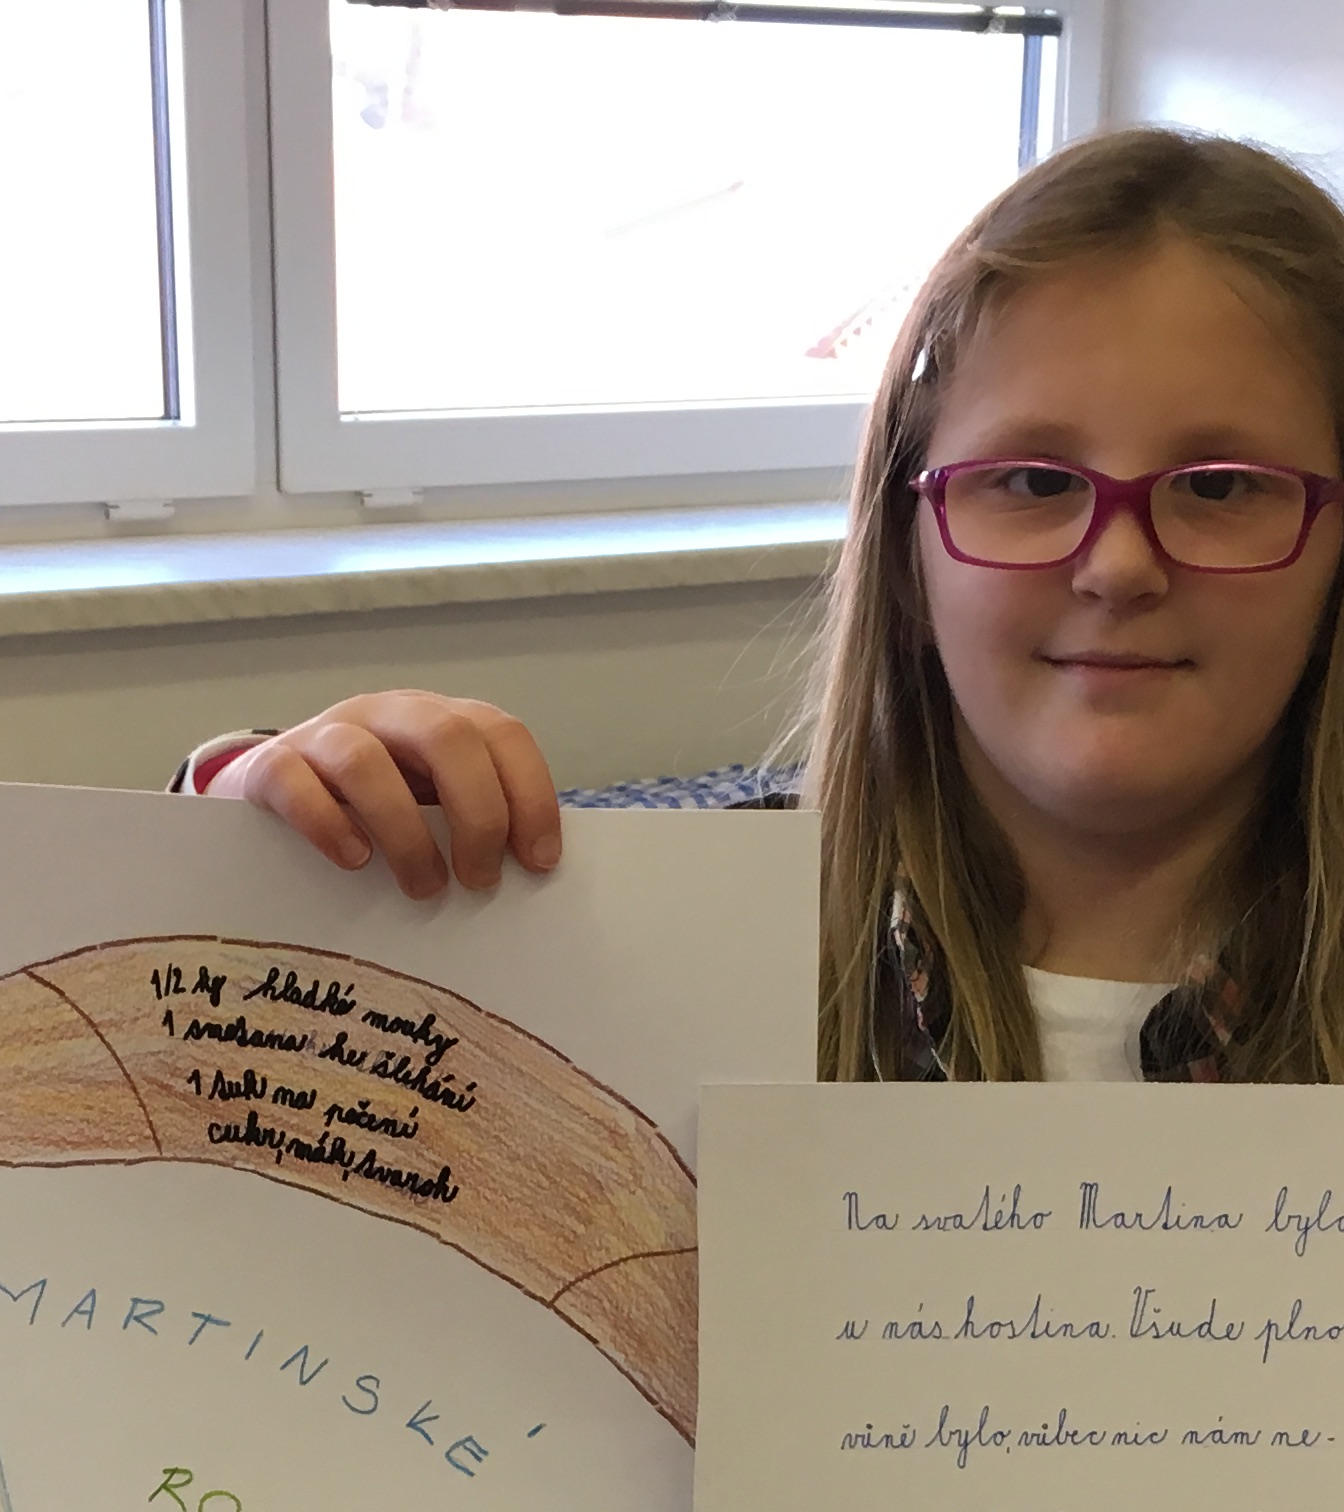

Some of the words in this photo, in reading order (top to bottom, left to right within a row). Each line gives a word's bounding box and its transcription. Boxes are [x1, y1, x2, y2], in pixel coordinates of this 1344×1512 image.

[150, 962, 187, 1000] 1/2
[191, 966, 227, 1007] kg
[361, 1012, 459, 1067] mouky
[161, 1009, 175, 1037] 1
[183, 1016, 308, 1053] smetana
[187, 1068, 202, 1096] 1
[207, 1068, 268, 1101] tuk
[271, 1086, 317, 1110] na
[843, 1191, 899, 1231] Na
[912, 1183, 1052, 1231] svatého
[1080, 1181, 1244, 1232] Martina
[835, 1319, 868, 1340] u
[882, 1302, 946, 1340] nás
[954, 1293, 1117, 1340] hostina.
[1129, 1285, 1245, 1341] Všude
[840, 1423, 916, 1450] vůně
[924, 1404, 1012, 1469] bylo,
[1017, 1408, 1107, 1447] vůbec
[1111, 1421, 1169, 1446] nic
[1181, 1415, 1262, 1446] nám
